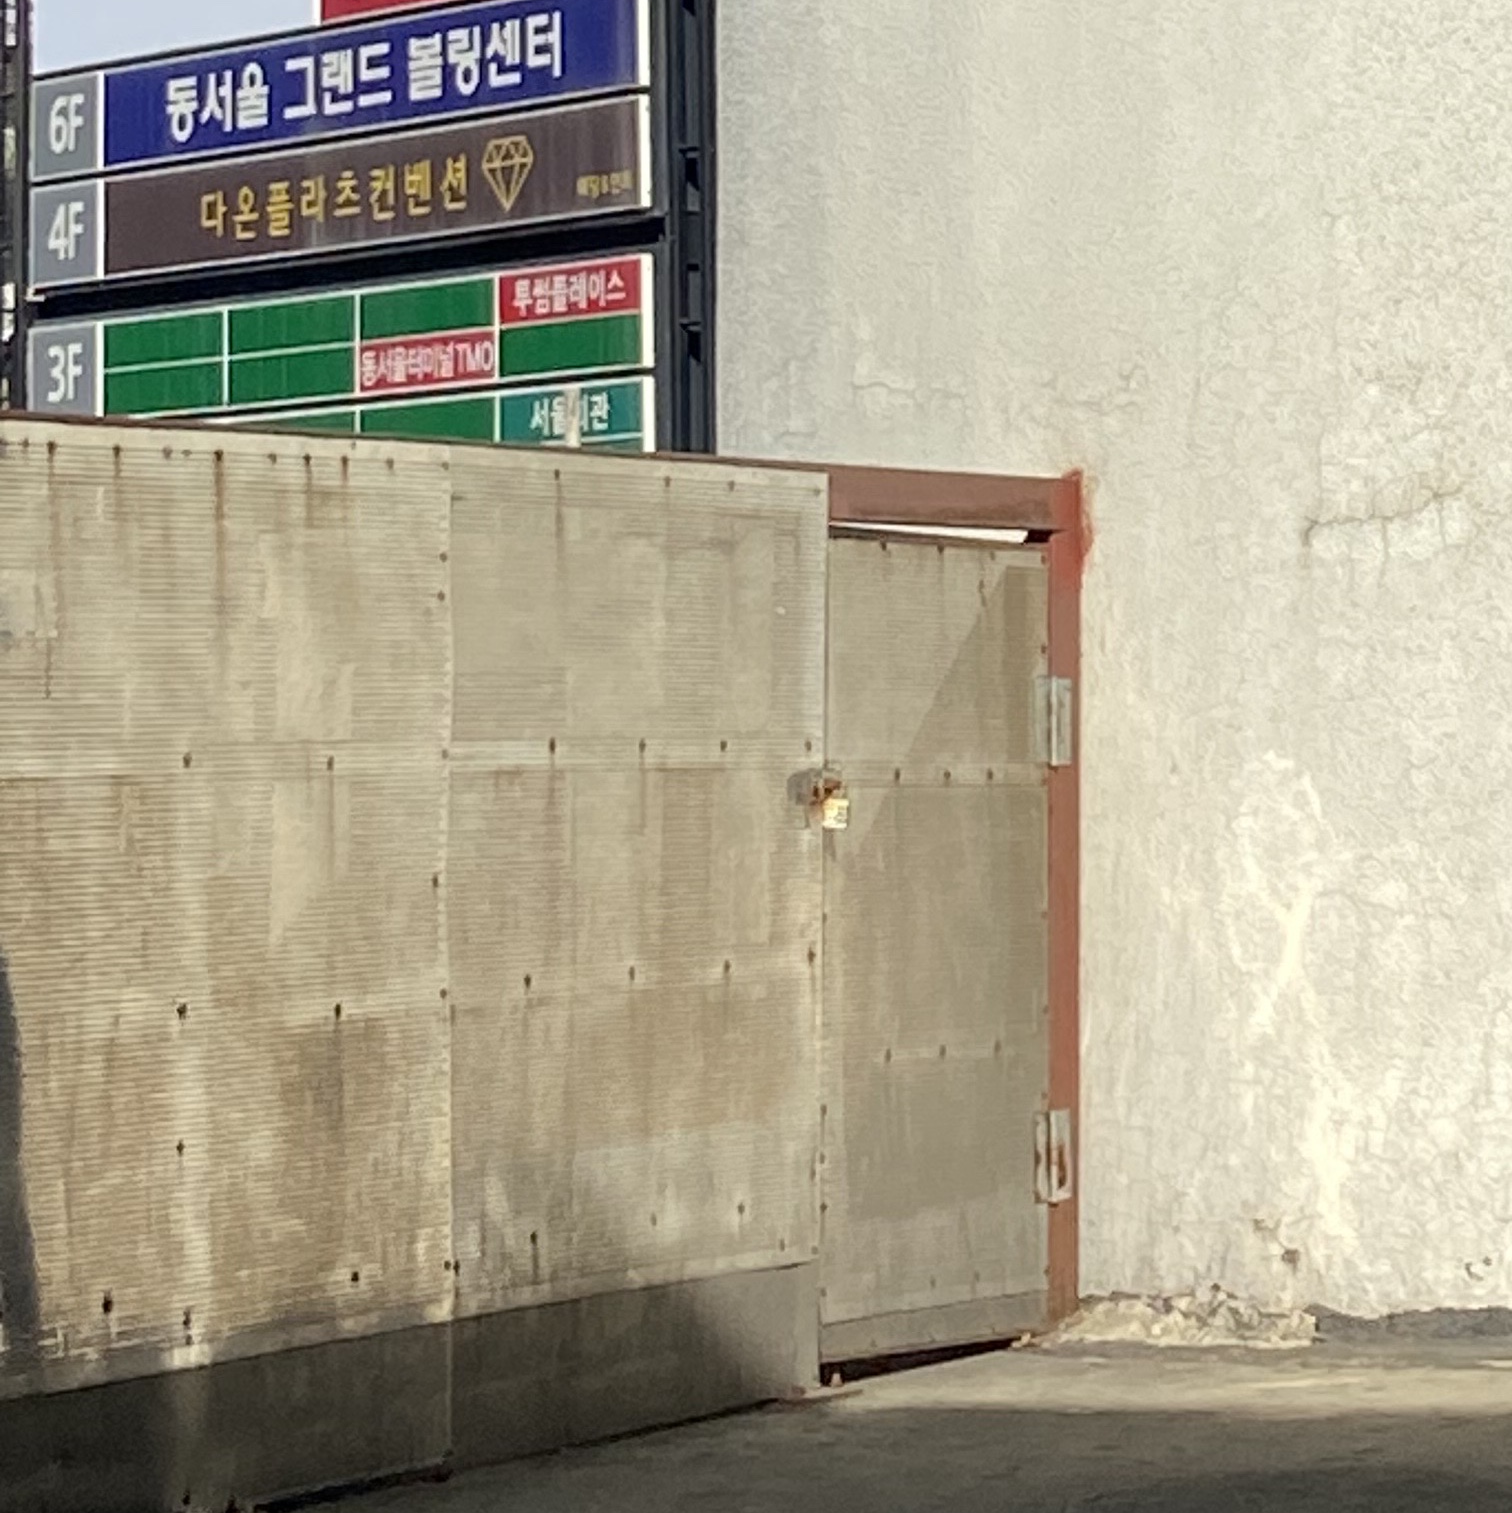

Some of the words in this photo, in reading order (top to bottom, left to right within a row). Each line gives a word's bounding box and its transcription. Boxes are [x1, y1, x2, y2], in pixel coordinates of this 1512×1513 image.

[164, 62, 270, 144] 동서울
[283, 40, 393, 120] 그랜드
[406, 10, 563, 103] 볼링센터
[49, 93, 86, 155] 6F
[47, 201, 85, 261] 4F
[512, 268, 627, 318] 투썸플레이스
[46, 343, 83, 404] 3F
